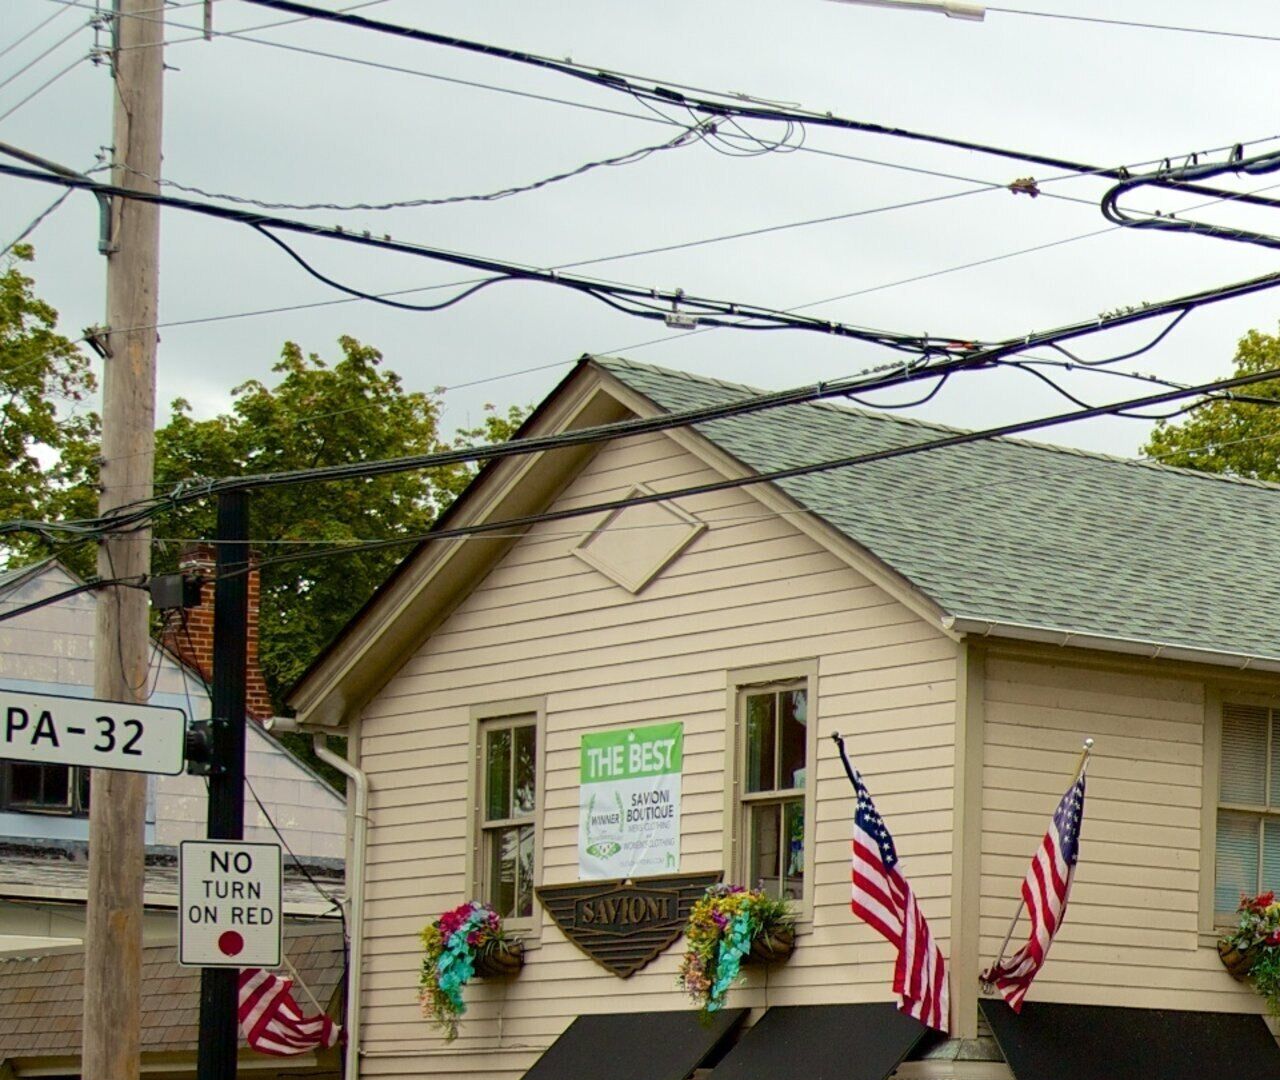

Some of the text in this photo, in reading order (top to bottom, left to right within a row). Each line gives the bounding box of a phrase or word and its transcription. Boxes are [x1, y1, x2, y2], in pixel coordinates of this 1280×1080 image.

[6, 706, 145, 757] PA-32
[587, 738, 676, 778] THE BEST
[631, 789, 670, 807] SAVIONI
[591, 813, 620, 826] WINNER
[626, 804, 674, 823] BOUTIQUE
[210, 850, 253, 874] NO
[202, 880, 261, 900] TURN
[188, 905, 274, 926] ON RED
[582, 896, 670, 925] SAVIONI
